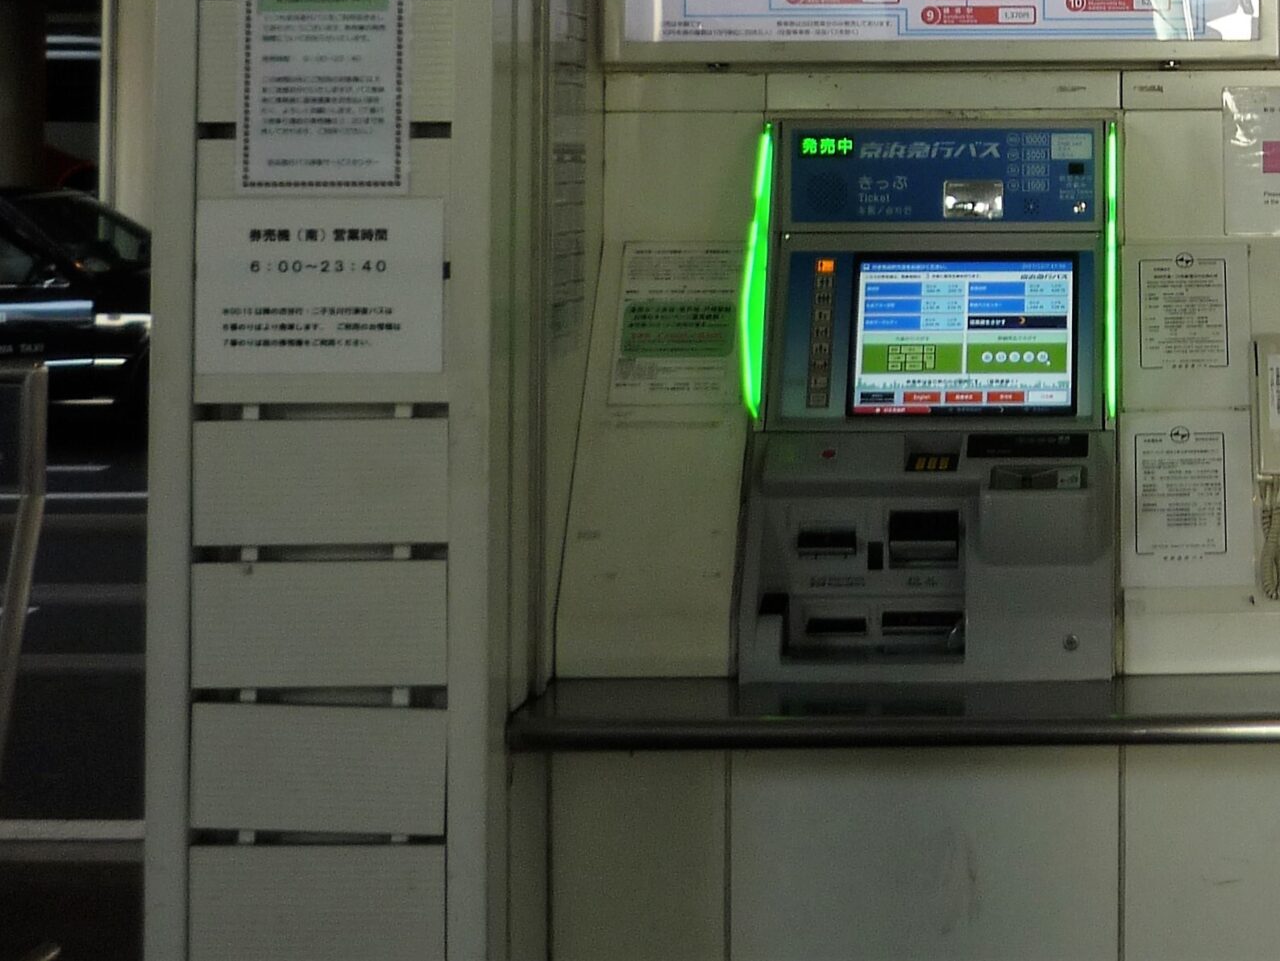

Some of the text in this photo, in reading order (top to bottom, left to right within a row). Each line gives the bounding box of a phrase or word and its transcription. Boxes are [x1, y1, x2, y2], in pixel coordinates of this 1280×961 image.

[802, 137, 853, 155] 発売中
[859, 141, 1001, 159] 京浜急行バス
[858, 175, 909, 191] きっぷ
[858, 193, 891, 203] Ticket
